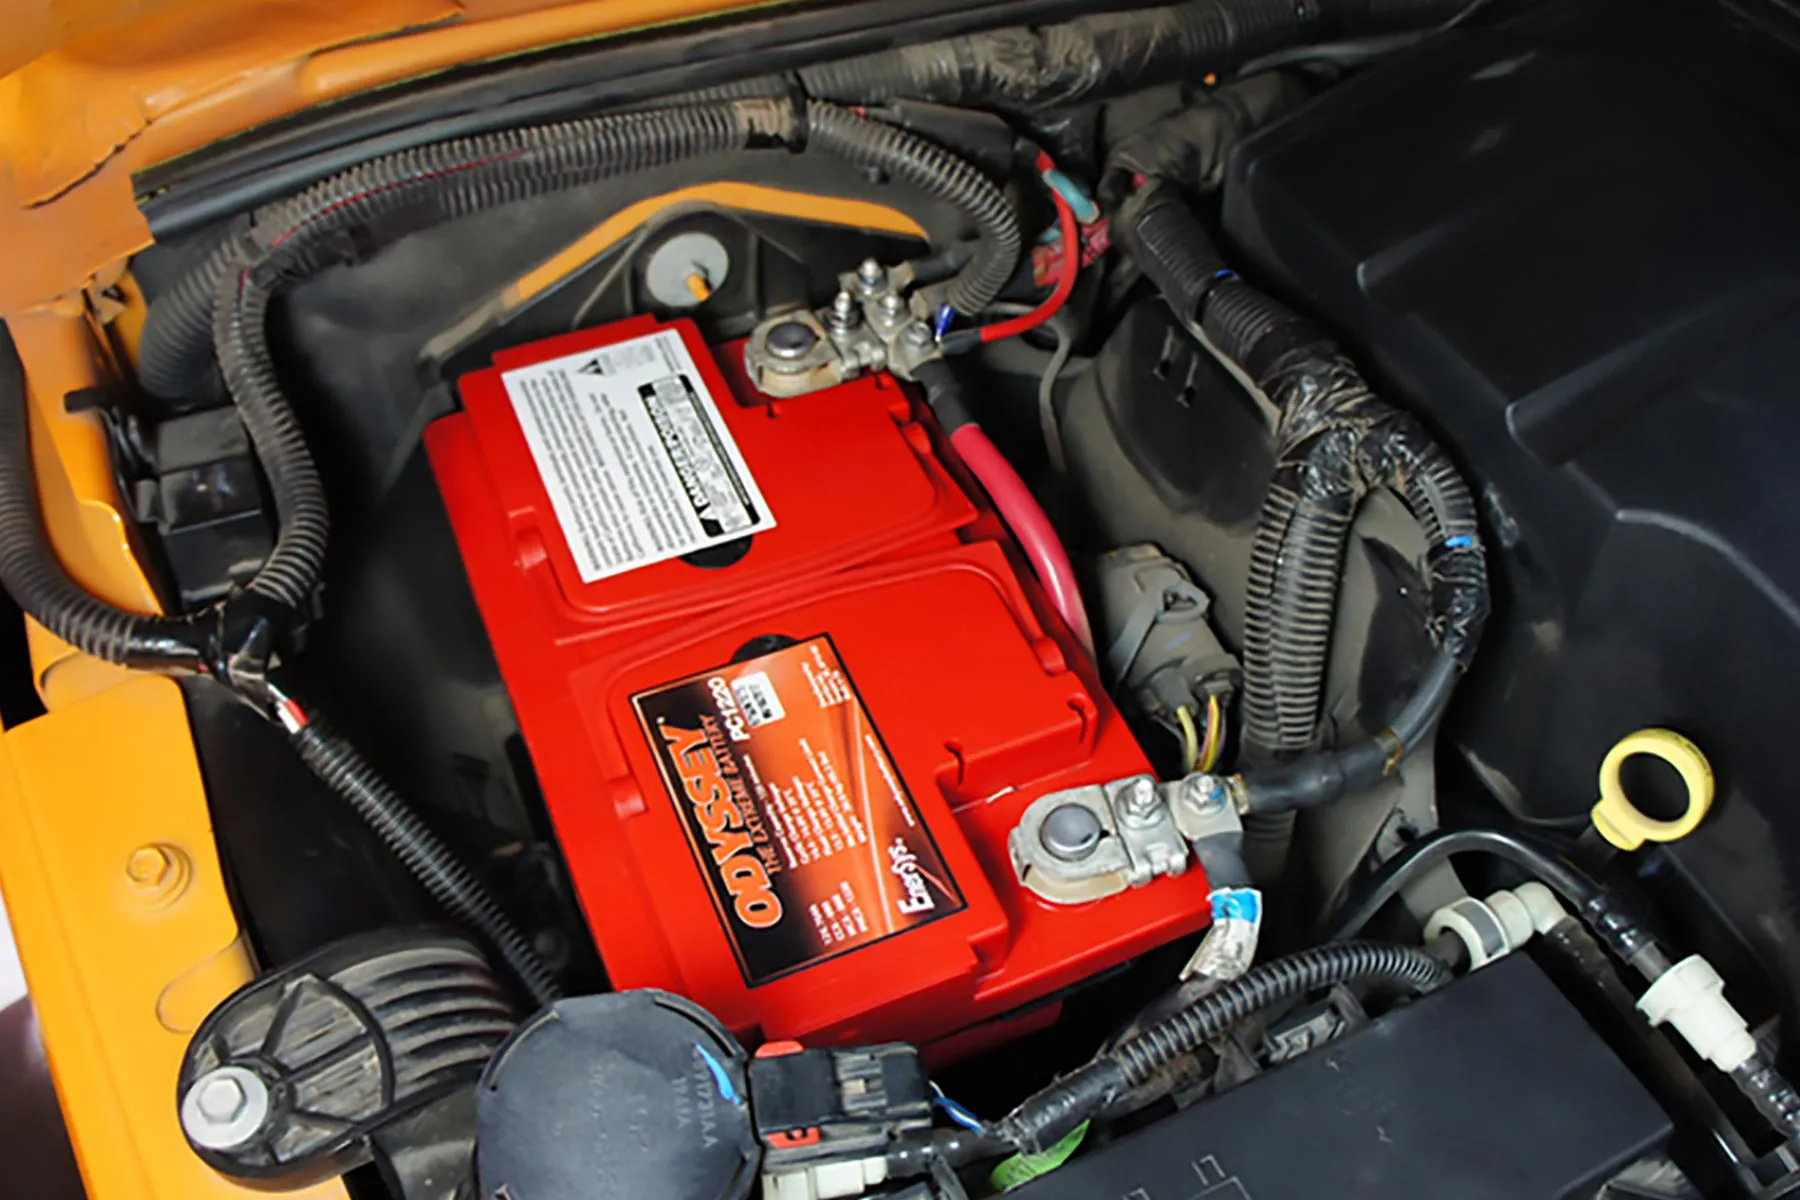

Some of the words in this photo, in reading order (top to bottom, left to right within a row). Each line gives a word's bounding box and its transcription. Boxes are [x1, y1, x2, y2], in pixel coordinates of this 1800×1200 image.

[707, 677, 750, 741] PC1220
[659, 725, 782, 927] ODYSSEY
[756, 845, 782, 875] THE
